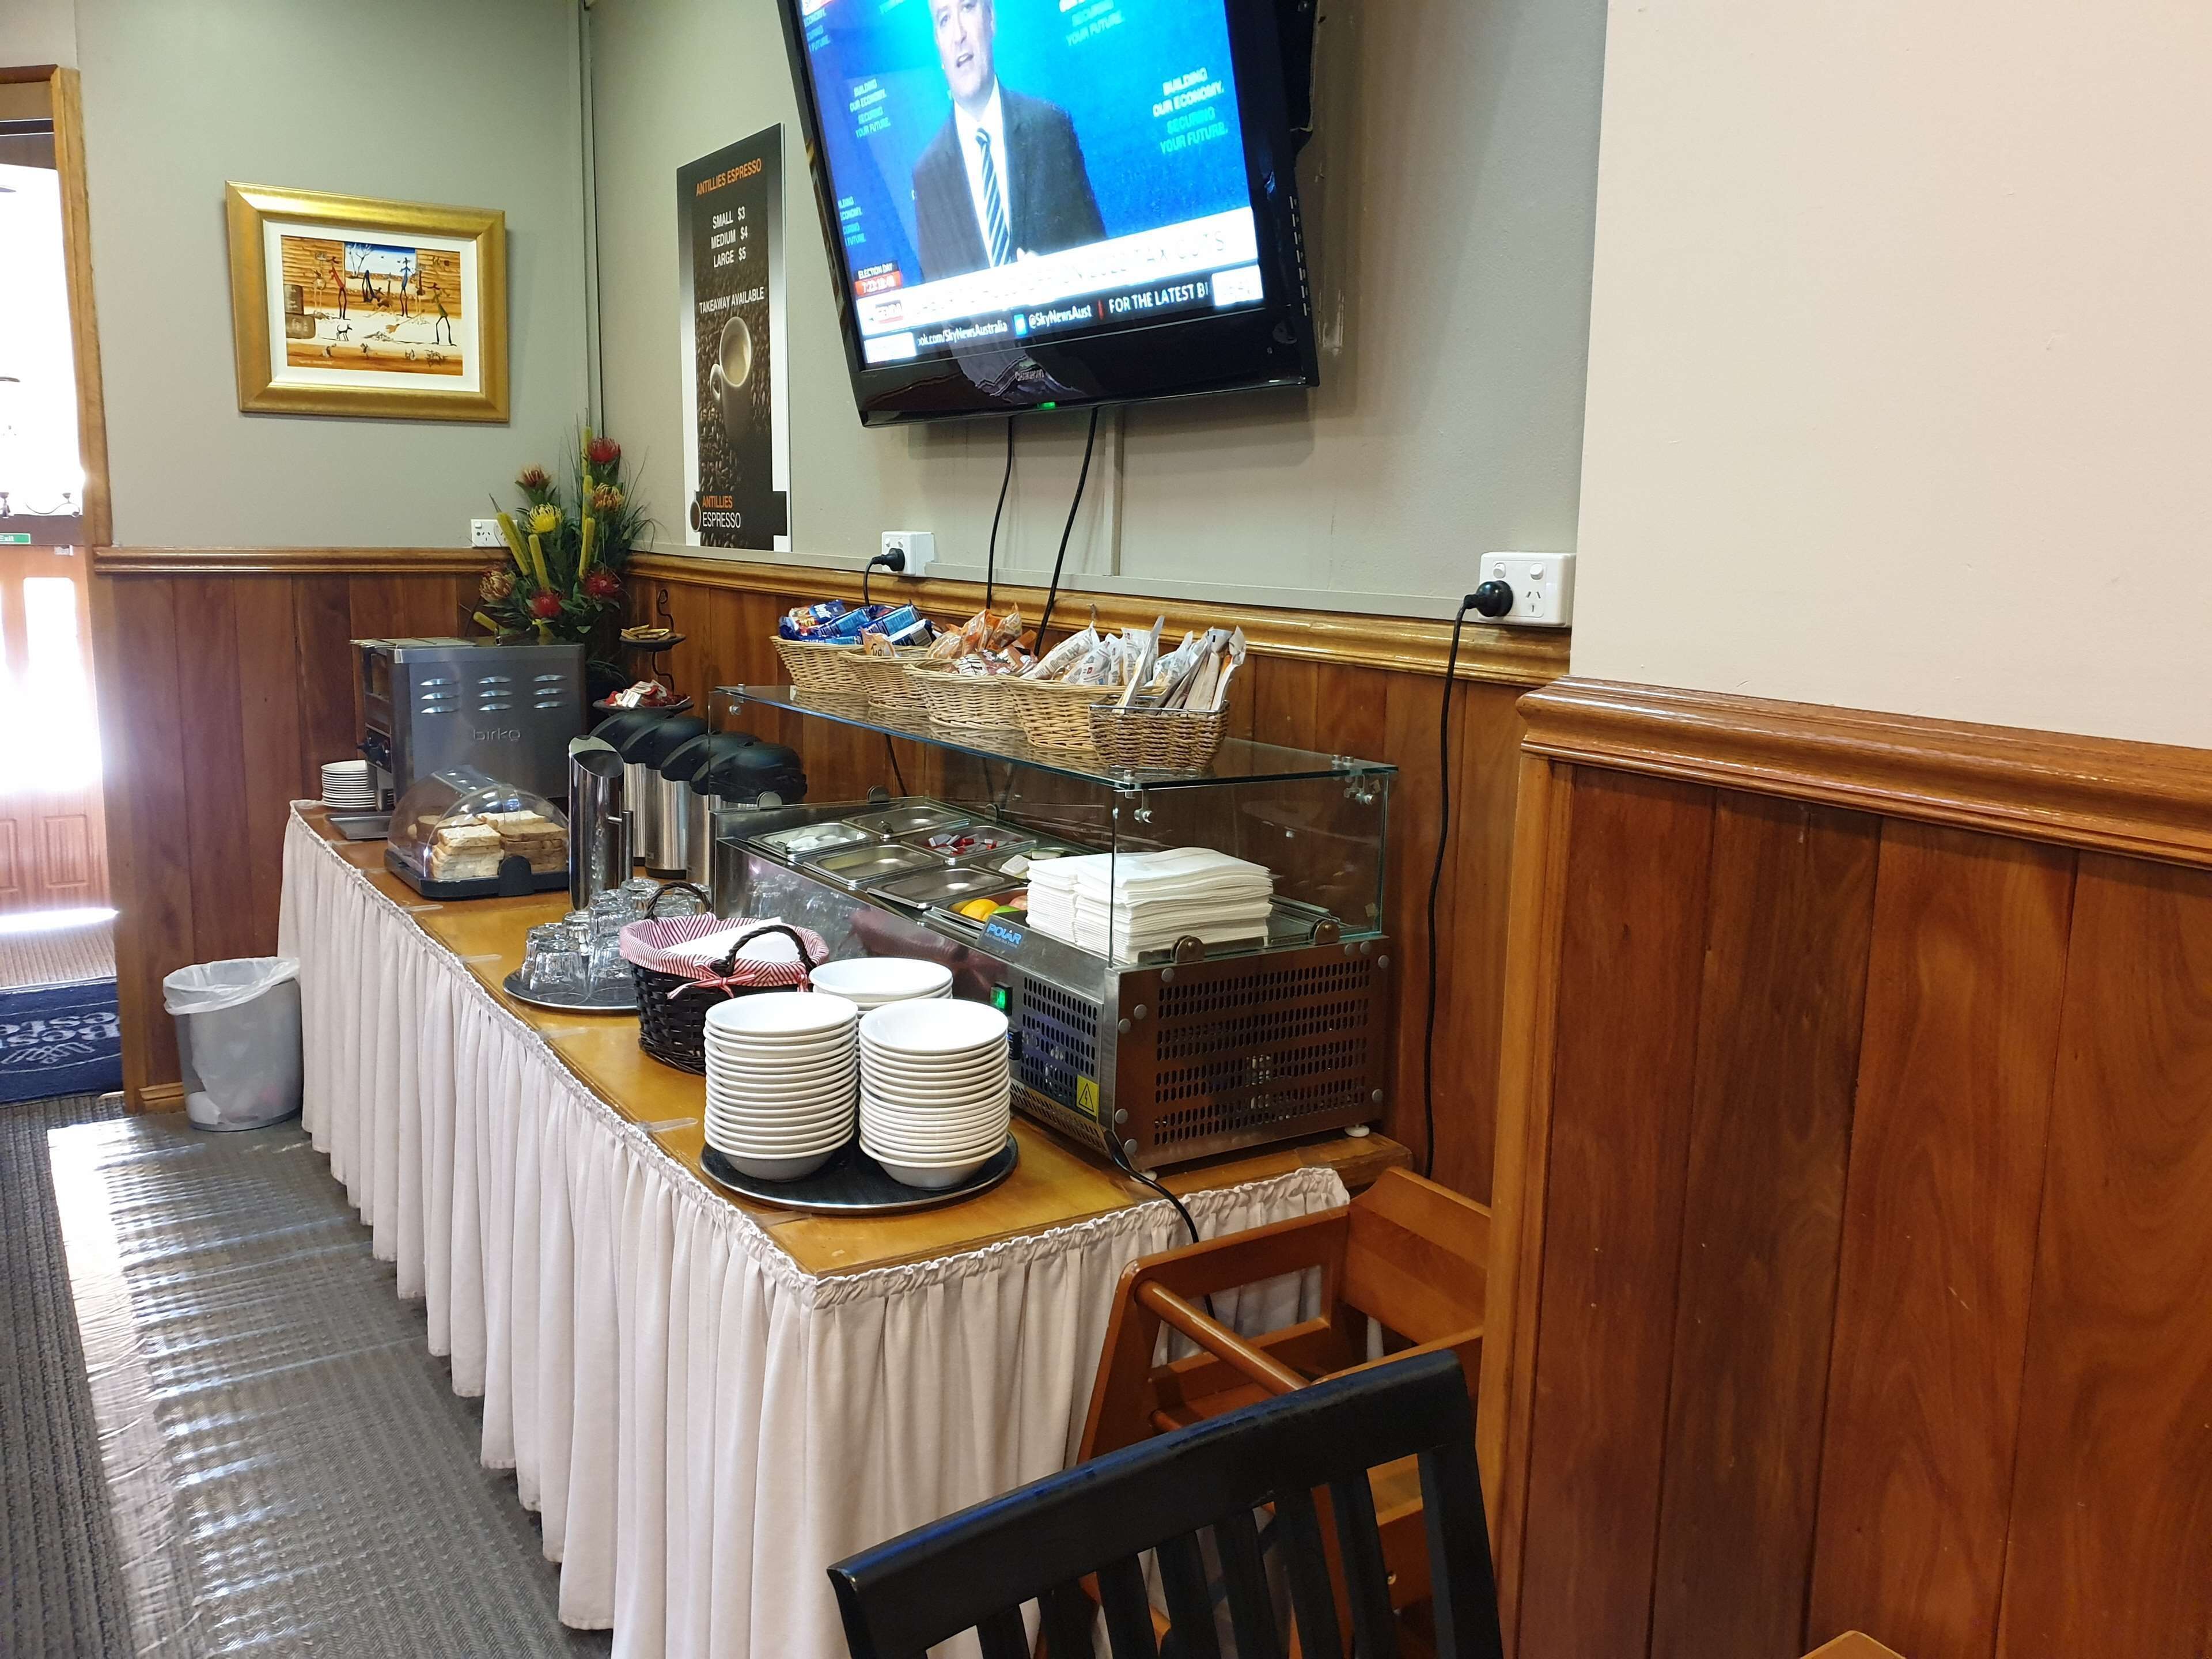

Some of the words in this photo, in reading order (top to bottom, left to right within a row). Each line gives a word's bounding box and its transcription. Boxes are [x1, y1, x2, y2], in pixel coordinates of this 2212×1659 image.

[1162, 67, 1208, 96] BUILDING
[1153, 99, 1173, 118] OUR
[1160, 135, 1186, 154] YOUR
[696, 172, 726, 196] ANTILLIES
[727, 158, 762, 184] ESPRESSO
[713, 210, 733, 229] SMALL
[737, 206, 745, 221] $3
[711, 229, 736, 249] MEDIUM
[740, 225, 748, 241] $4
[714, 250, 734, 268] LARGE
[738, 247, 747, 262] $5
[858, 265, 882, 279] ELECTION
[882, 263, 892, 273] DAY
[699, 296, 730, 314] TAKEAWAY
[731, 286, 764, 306] AVAILABLE
[1108, 297, 1131, 313] FOR
[1131, 291, 1153, 309] THE
[1154, 283, 1194, 306] LATEST
[702, 495, 733, 508] ANTILLIES
[702, 512, 741, 528] ESPRESSO
[473, 728, 521, 742] birko
[986, 923, 1022, 945] POLAR
